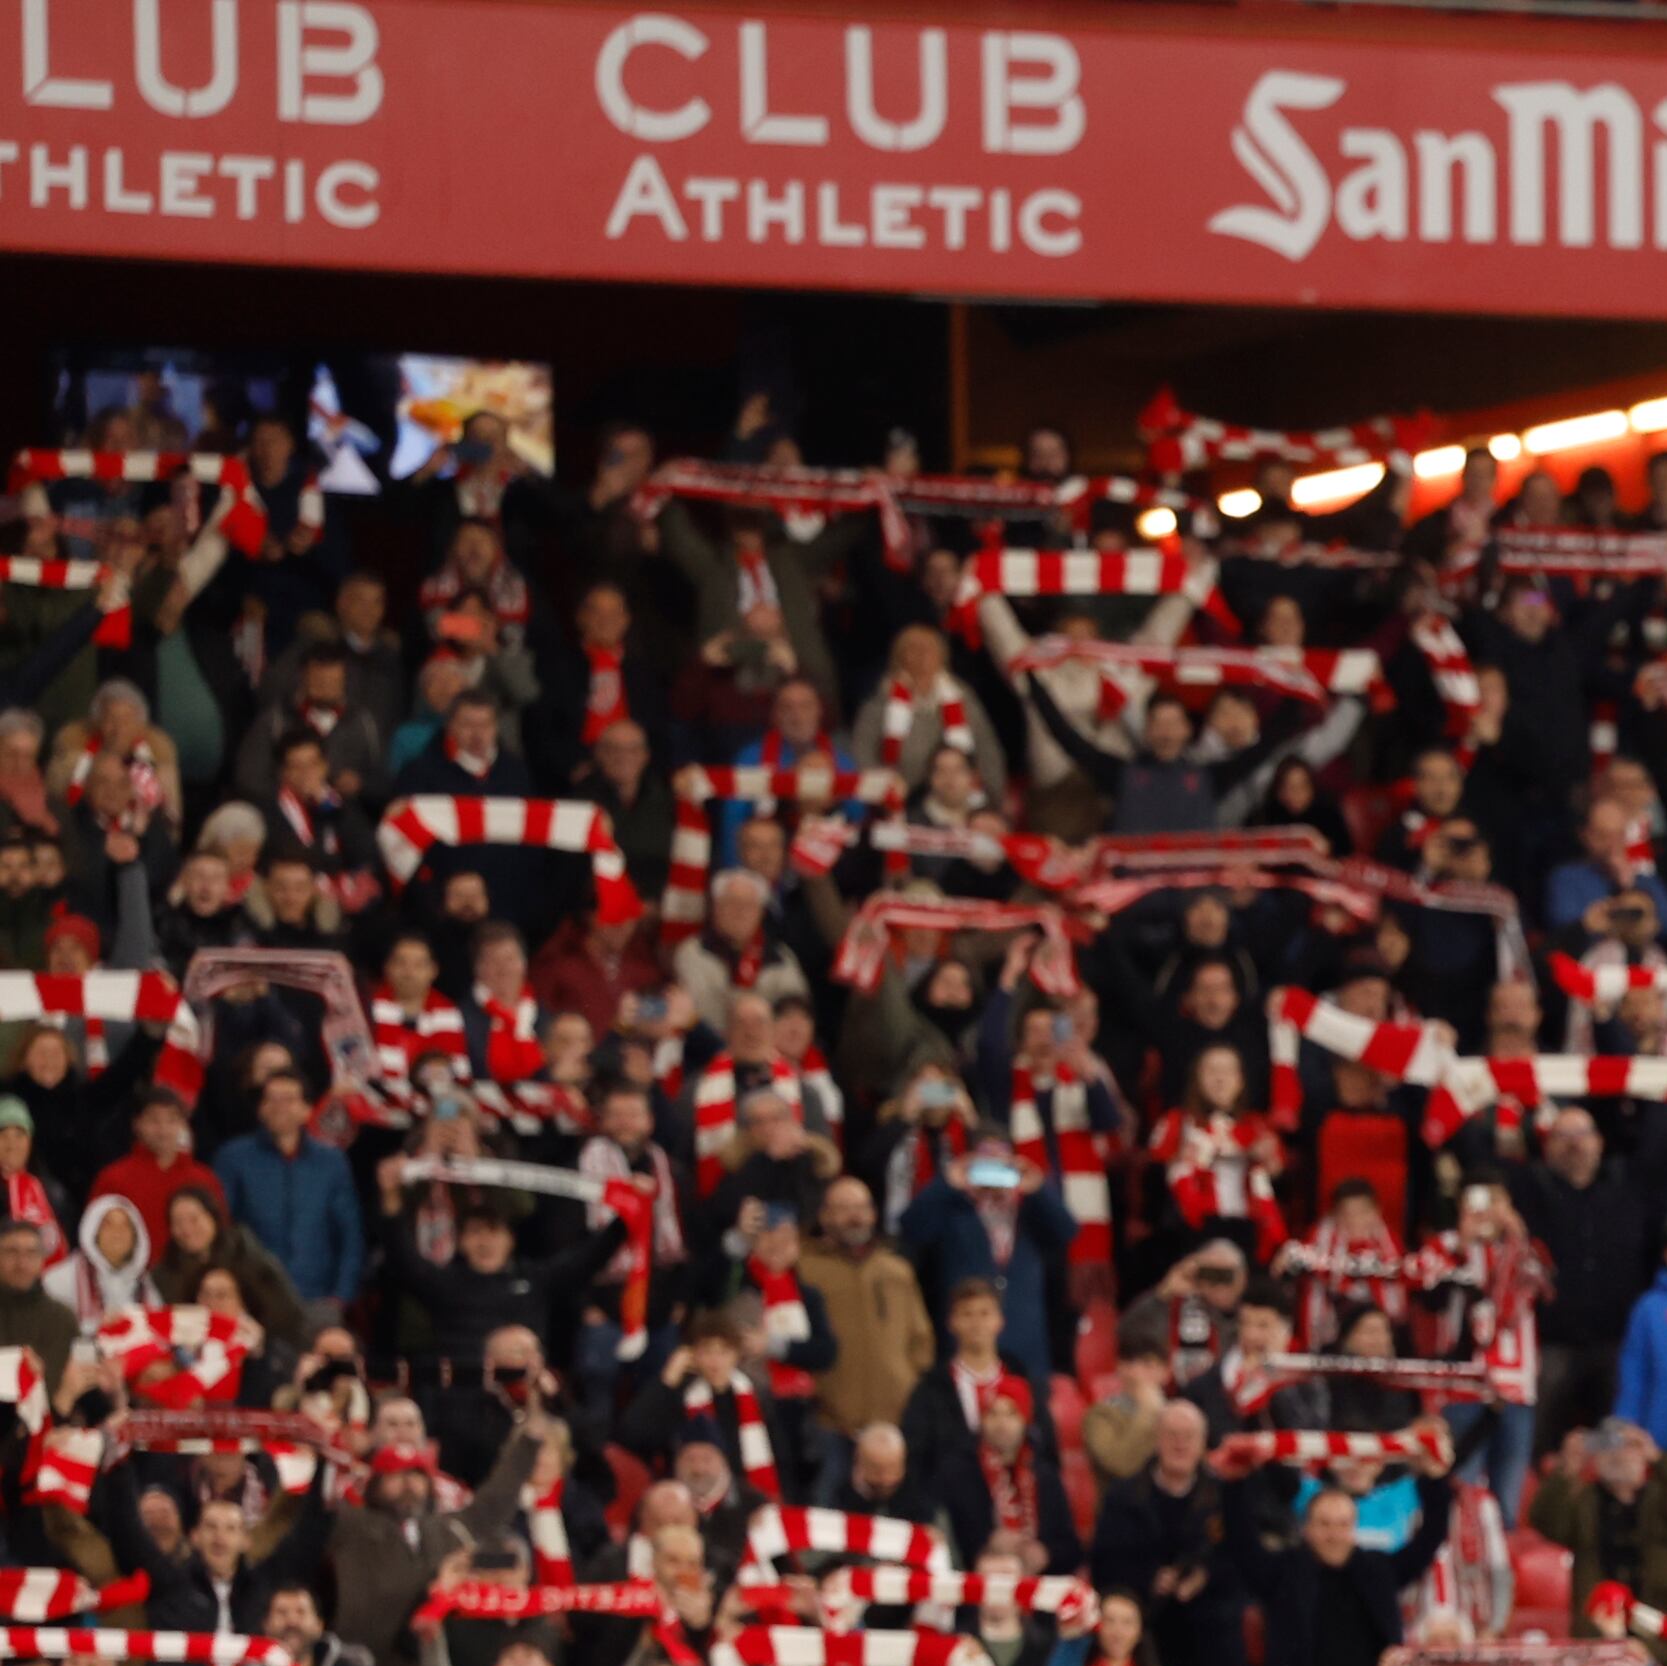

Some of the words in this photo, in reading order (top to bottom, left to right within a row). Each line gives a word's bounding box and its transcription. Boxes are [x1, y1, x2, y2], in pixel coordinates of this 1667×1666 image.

[21, 0, 384, 125] LUB
[595, 15, 1087, 156] CLUB
[0, 142, 380, 228] HLETIC
[606, 155, 1083, 256] ATHLETIC
